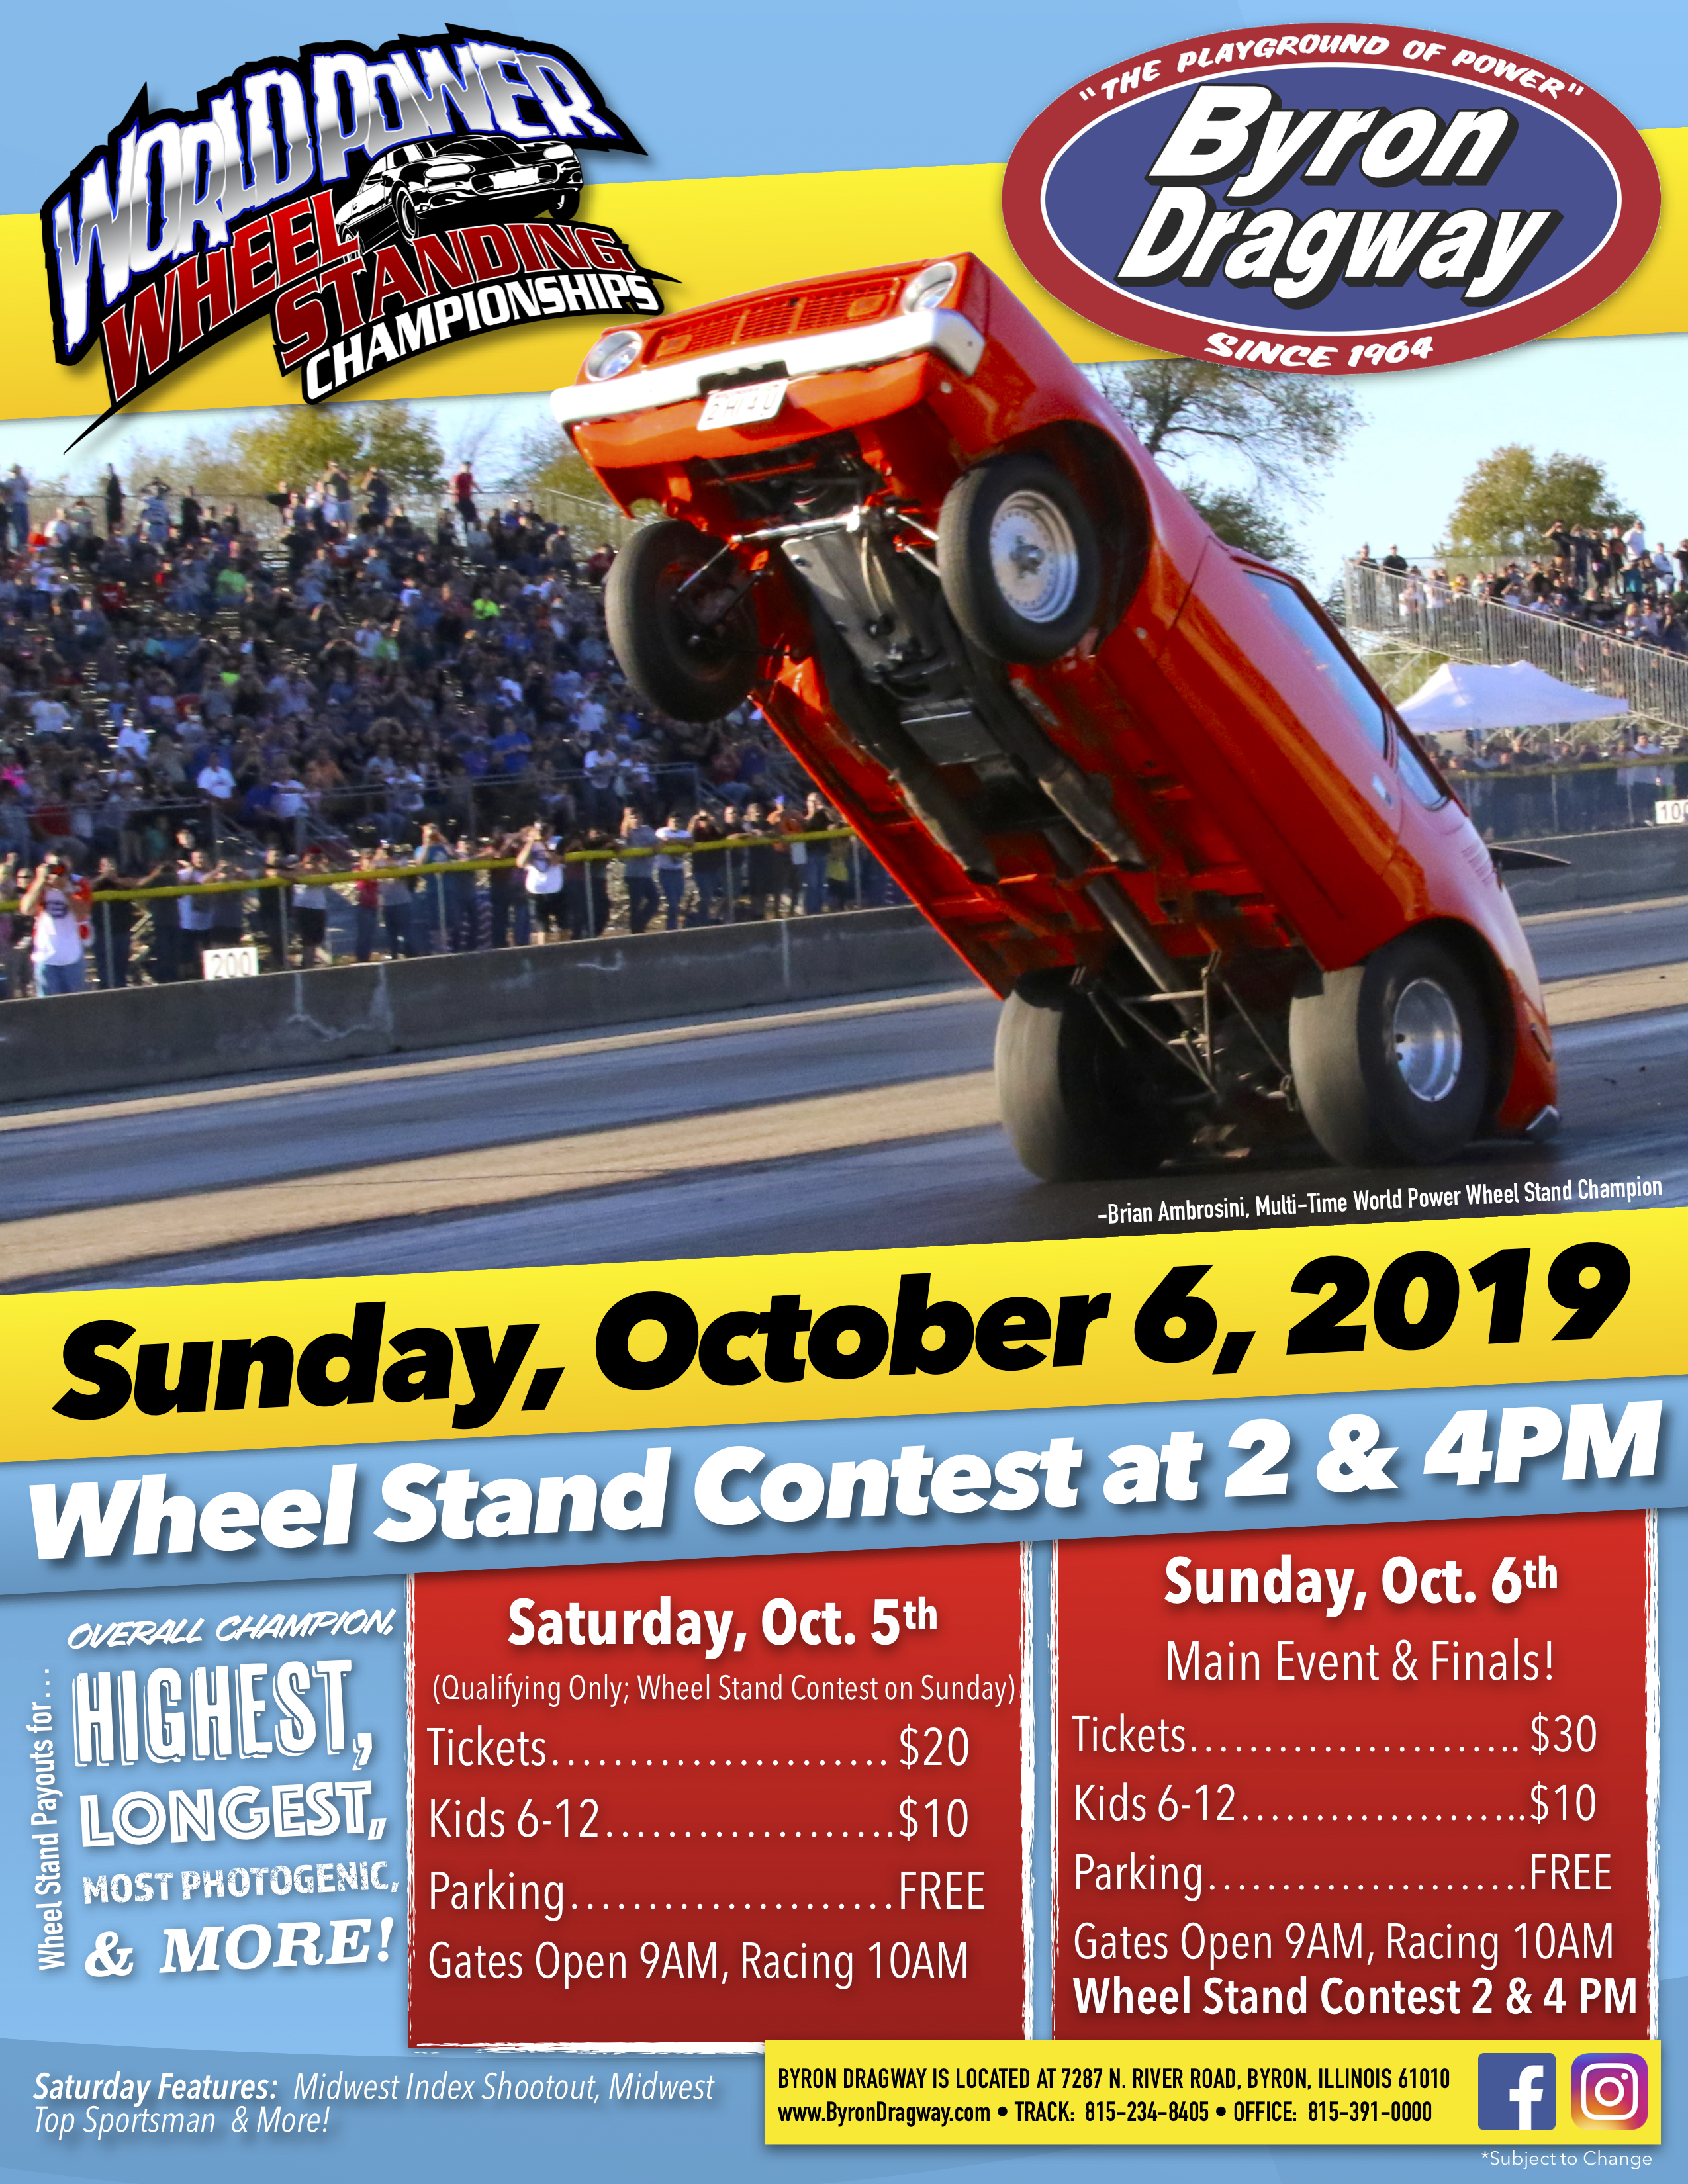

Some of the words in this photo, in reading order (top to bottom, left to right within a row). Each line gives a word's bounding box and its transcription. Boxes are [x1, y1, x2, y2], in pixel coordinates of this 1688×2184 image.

[1178, 34, 1389, 72] PLAYGROUND
[1403, 41, 1446, 61] OF
[1147, 84, 1512, 199] Byron
[53, 65, 308, 353] WORLD
[314, 41, 621, 185] POWER
[1116, 186, 1554, 304] Dragway
[102, 189, 361, 402] WHEEL
[273, 223, 637, 370] STANDING
[305, 273, 659, 402] CHAMPIONSHIPS
[1205, 333, 1338, 367] SINCE
[1348, 337, 1433, 367] 1964
[212, 951, 252, 979] 200
[1098, 1203, 1152, 1224] -Brian
[1158, 1197, 1249, 1221] Ambrosini,
[1256, 1193, 1346, 1216] Multi-Time
[1354, 1189, 1401, 1210] World
[1409, 1188, 1461, 1208] Power
[1466, 1183, 1519, 1205] Wheel
[1524, 1180, 1571, 1202] Stand
[1579, 1176, 1662, 1202] Champion
[52, 1302, 565, 1429] Sunday,
[596, 1273, 1111, 1390] October
[1135, 1265, 1256, 1375] 6,
[1286, 1242, 1630, 1355] 2019
[29, 1464, 357, 1559] Wheel
[373, 1447, 671, 1542] Stand
[694, 1437, 1082, 1525] Contest
[1103, 1431, 1203, 1504] at
[1225, 1419, 1290, 1497] 2
[1317, 1414, 1399, 1492] &
[1423, 1400, 1662, 1485] 4PM
[1165, 1555, 1366, 1617] Sunday,
[1382, 1557, 1476, 1604] Oct.
[1492, 1556, 1557, 1603] 6th
[68, 1618, 205, 1649] OVERALL
[216, 1608, 396, 1641] CHAMPION,
[508, 1596, 746, 1659] Saturday,
[762, 1598, 855, 1645] Oct.
[871, 1597, 937, 1645] 5th
[1168, 1641, 1259, 1680] Main
[1278, 1641, 1379, 1680] Event
[1393, 1640, 1418, 1680] &
[1433, 1638, 1552, 1680] Finals!
[434, 1674, 559, 1707] (Qualifying
[570, 1674, 628, 1707] Only;
[637, 1674, 709, 1700] Wheel
[719, 1674, 781, 1700] Stand
[792, 1675, 878, 1700] Contest
[886, 1682, 912, 1700] on
[921, 1674, 1014, 1707] Sunday)
[72, 1660, 372, 1770] HIGHEST,
[1532, 1712, 1596, 1755] $30
[900, 1724, 968, 1769] $20
[30, 1740, 63, 1825] Payouts
[1076, 1782, 1145, 1821] Kids
[1531, 1781, 1595, 1824] $10
[80, 1781, 387, 1847] LONGEST,
[432, 1797, 504, 1837] Kids
[900, 1796, 967, 1841] $10
[32, 1833, 61, 1895] Stand
[82, 1872, 173, 1905] MOST
[181, 1860, 399, 1901] PHOTOGENIC,
[1532, 1854, 1611, 1889] FREE
[902, 1872, 984, 1909] FREE
[36, 1901, 65, 1970] Wheel
[85, 1931, 133, 1977] &
[159, 1917, 393, 1973] MORE!
[1075, 1923, 1167, 1959] Gates
[1182, 1923, 1271, 1970] Open
[1286, 1923, 1373, 1965] 9AM,
[1388, 1923, 1497, 1970] Racing
[1515, 1923, 1611, 1959] 10AM
[430, 1942, 522, 1978] Gates
[536, 1942, 626, 1989] Open
[641, 1942, 727, 1984] 9AM,
[743, 1942, 852, 1989] Racing
[869, 1942, 966, 1978] 10AM
[1073, 1976, 1189, 2014] Wheel
[1203, 1976, 1306, 2014] Stand
[1321, 1978, 1460, 2014] Contest
[1473, 1978, 1492, 2013] 2
[1507, 1978, 1532, 2014] &
[1544, 1978, 1566, 2013] 4
[1581, 1978, 1635, 2013] PM
[33, 2071, 151, 2107] Saturday
[158, 2073, 277, 2099] Features:
[294, 2071, 400, 2099] Midwest
[406, 2071, 475, 2099] Index
[482, 2071, 599, 2103] Shootout,
[609, 2071, 715, 2099] Midwest
[779, 2068, 836, 2088] BYRON
[844, 2068, 927, 2088] DRAGWAY
[933, 2068, 949, 2088] IS
[957, 2068, 1029, 2088] LOCATED
[1037, 2068, 1056, 2088] AT
[1062, 2068, 1102, 2088] 7287
[1110, 2068, 1125, 2088] N.
[1133, 2068, 1183, 2088] RIVER
[1191, 2068, 1241, 2089] ROAD,
[1248, 2068, 1311, 2089] BYRON,
[1319, 2068, 1391, 2088] ILLINOIS
[1399, 2068, 1449, 2088] 61010
[36, 2107, 74, 2140] Top
[83, 2106, 214, 2140] Sportsman
[232, 2106, 248, 2132] &
[257, 2107, 330, 2132] More!
[778, 2101, 990, 2127] www.ByronDragway.com
[1015, 2101, 1074, 2121] TRACK:
[1086, 2101, 1208, 2121] 815-234-8405
[1235, 2101, 1296, 2121] OFFICE:
[1309, 2101, 1431, 2121] 815-391-0000
[1560, 2154, 1577, 2165] to
[1584, 2150, 1652, 2169] Change
